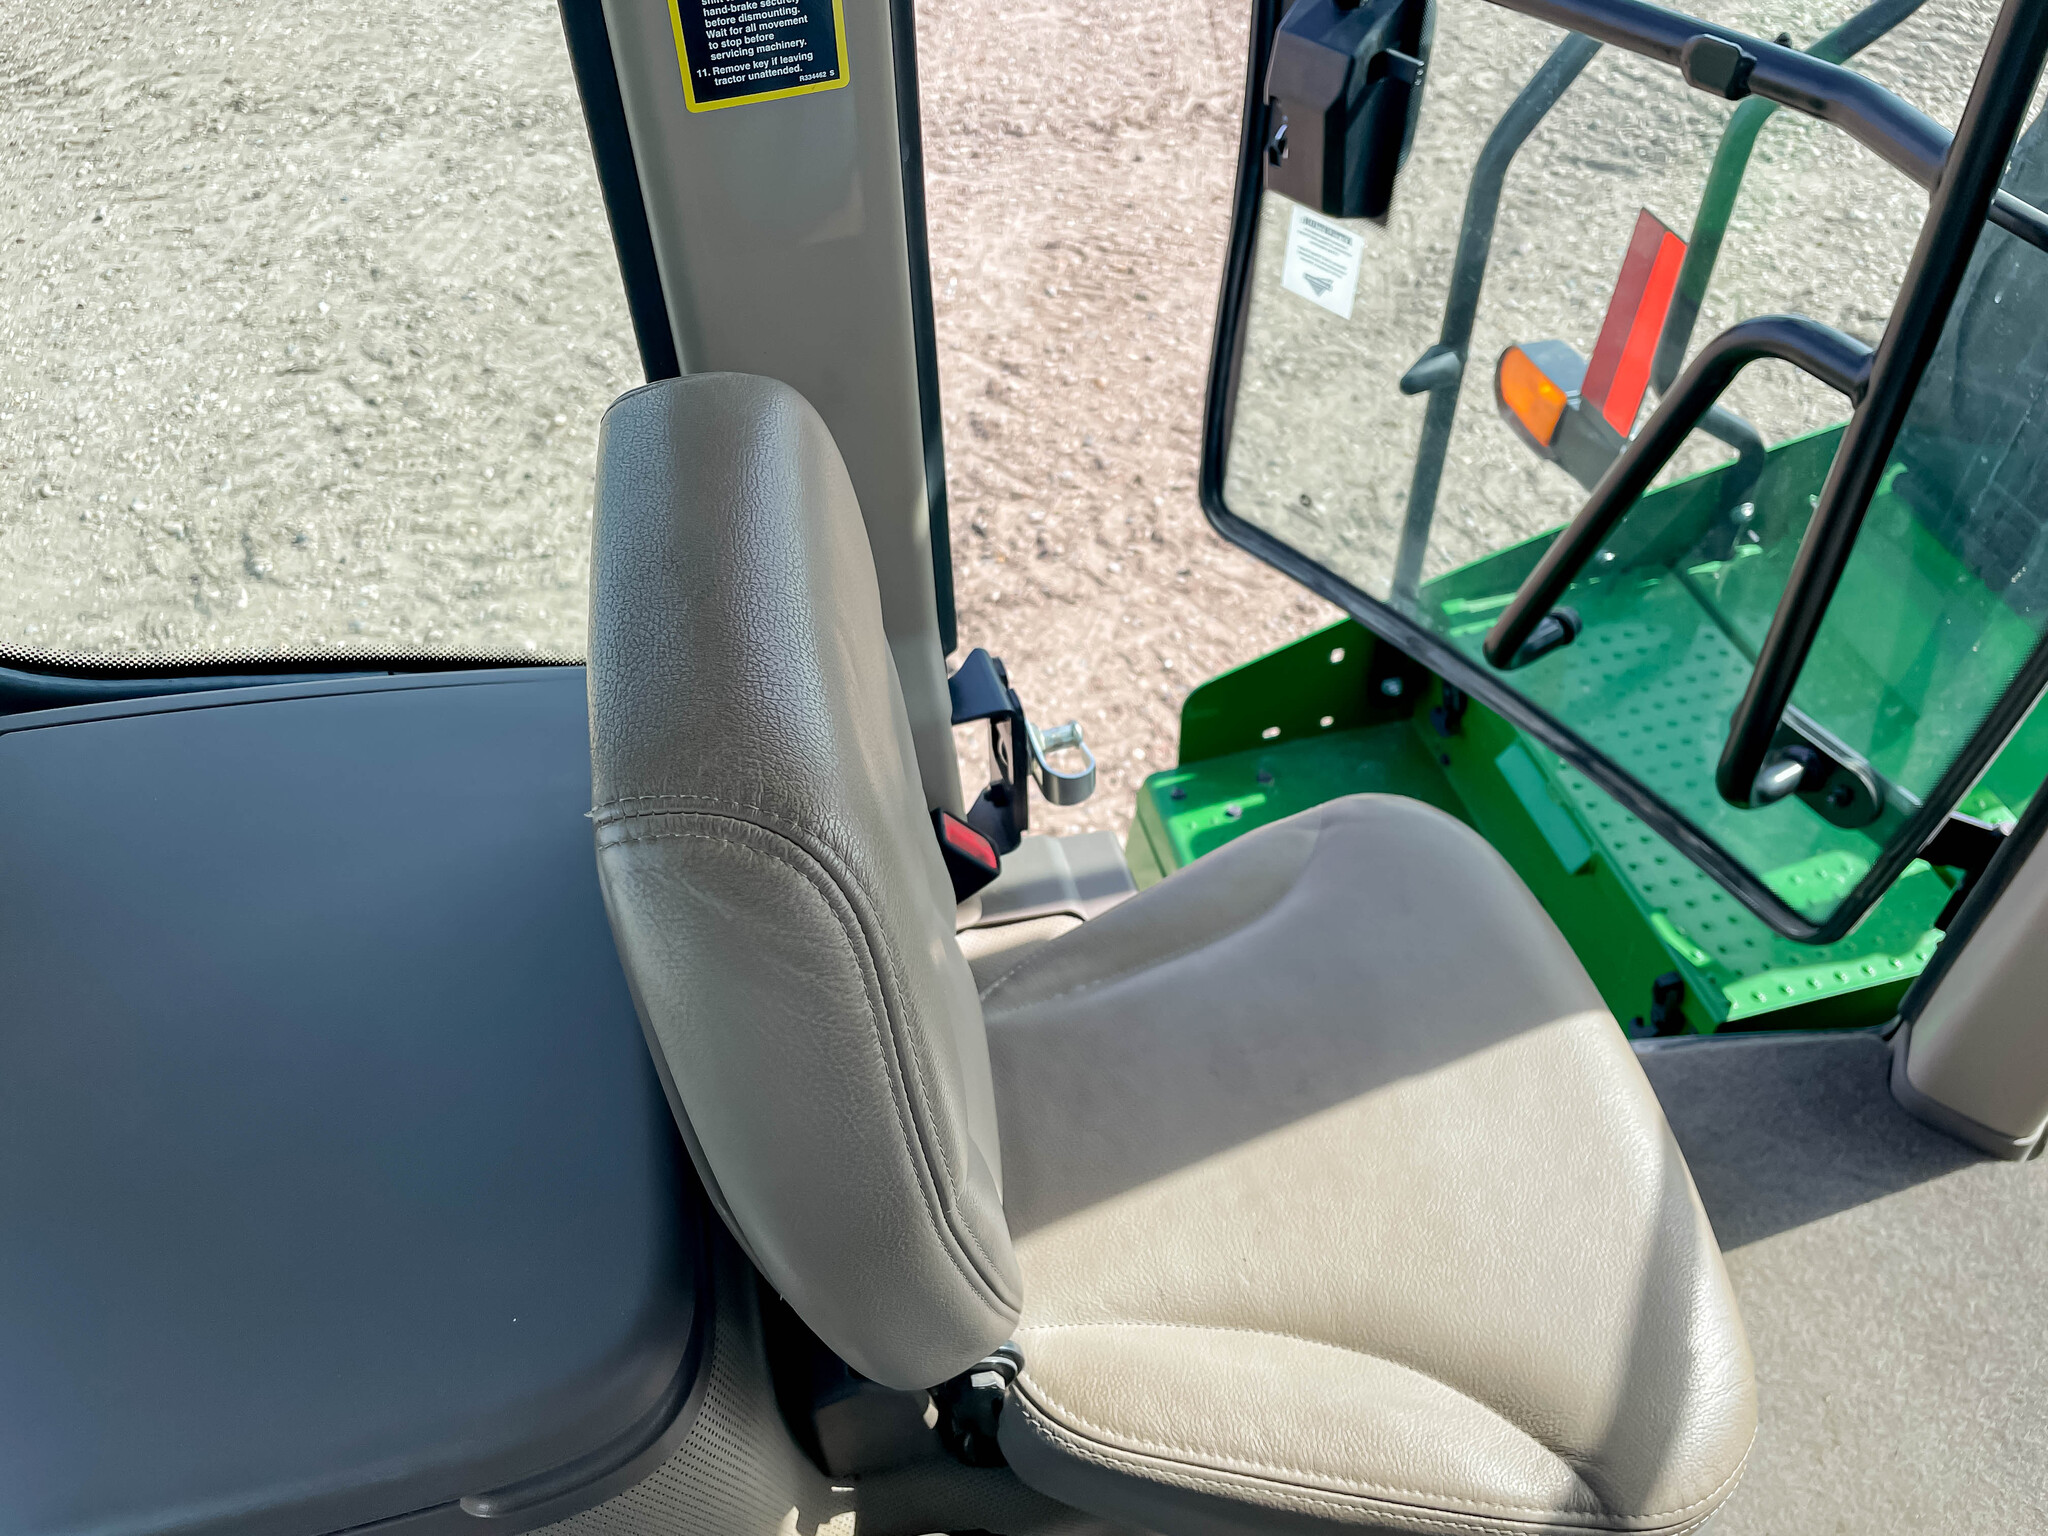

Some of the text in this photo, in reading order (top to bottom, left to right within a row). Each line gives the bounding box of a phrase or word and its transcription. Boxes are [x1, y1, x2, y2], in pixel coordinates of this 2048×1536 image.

[703, 1, 758, 17] hand-brake
[704, 6, 800, 28] before dismounting.
[706, 15, 808, 39] Wait for all movement
[708, 32, 775, 50] to stop before
[710, 38, 807, 61] servicing machinery.
[696, 51, 813, 78] 11. Remove key if leaving
[714, 64, 803, 86] tractor unattended.
